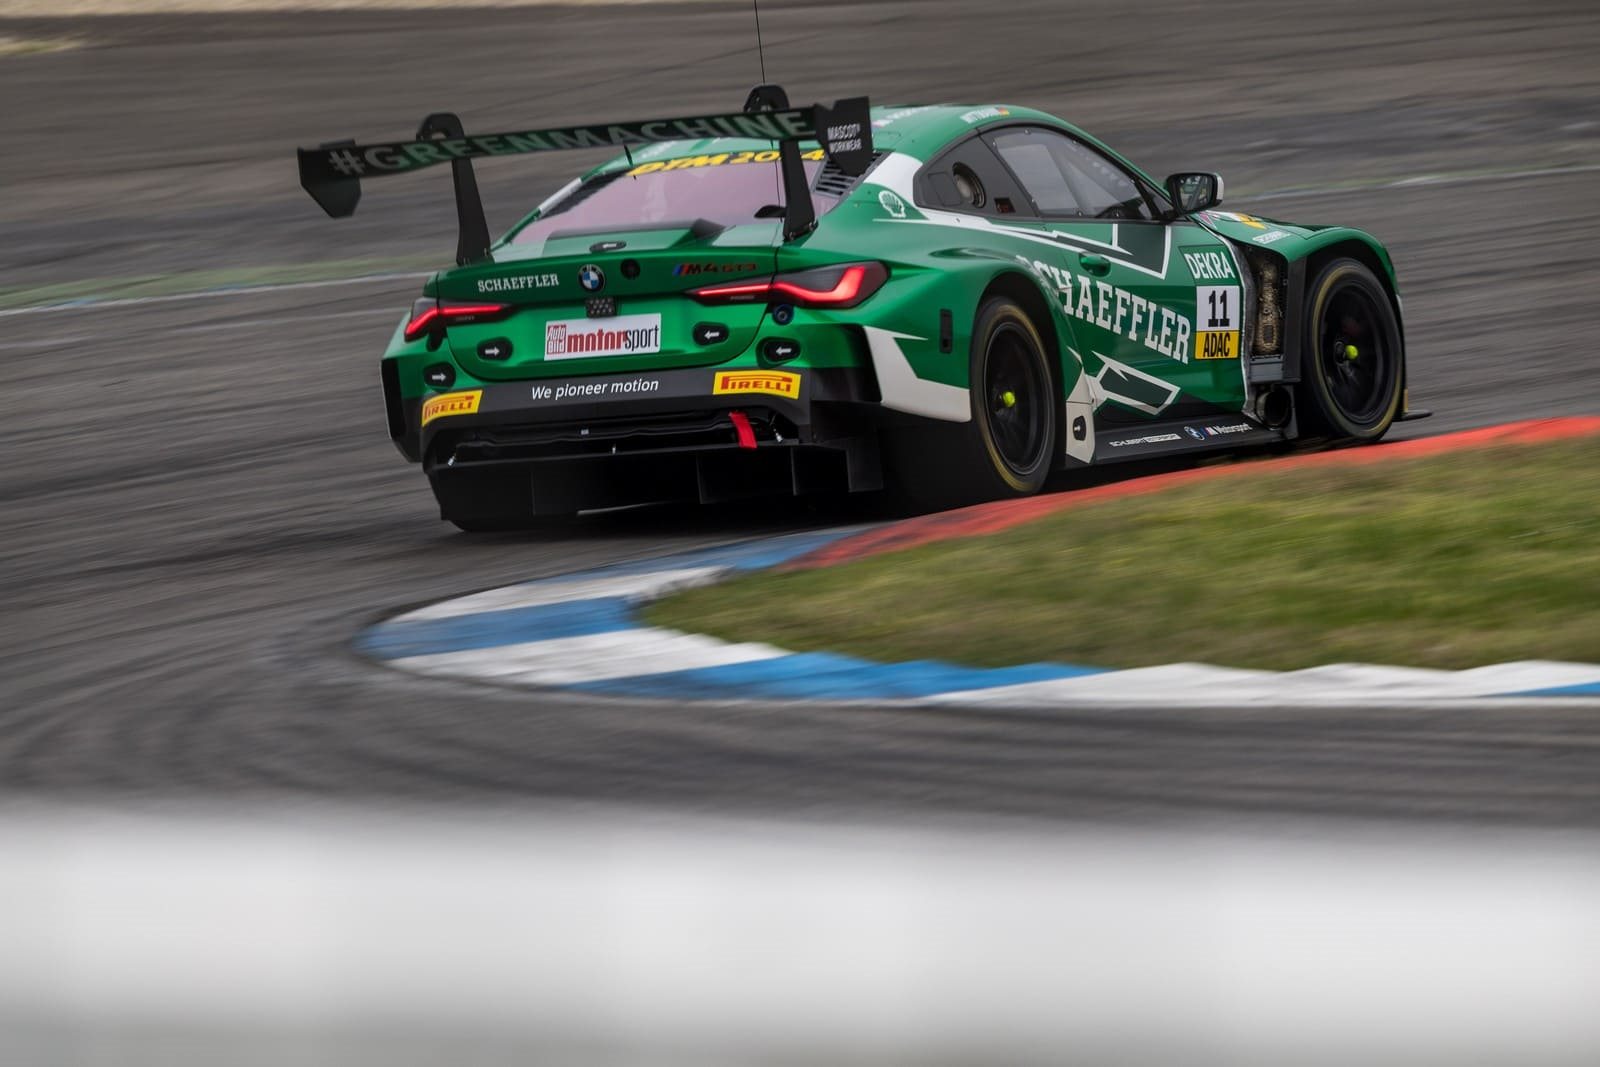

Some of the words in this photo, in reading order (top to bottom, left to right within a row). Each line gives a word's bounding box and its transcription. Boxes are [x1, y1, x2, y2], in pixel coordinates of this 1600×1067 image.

[329, 112, 817, 175] #GREENMACHINE
[829, 138, 862, 153] WORKWEAR
[729, 149, 825, 164] 204
[1183, 251, 1236, 279] DEKRA
[478, 273, 560, 293] SCHAEFFLER
[1208, 290, 1230, 327] 11
[1203, 332, 1230, 357] ADAC
[531, 386, 552, 401] We
[555, 383, 608, 401] pioneer
[610, 378, 659, 394] motion
[720, 374, 793, 393] PIRELLI
[424, 395, 475, 421] PIRELLI
